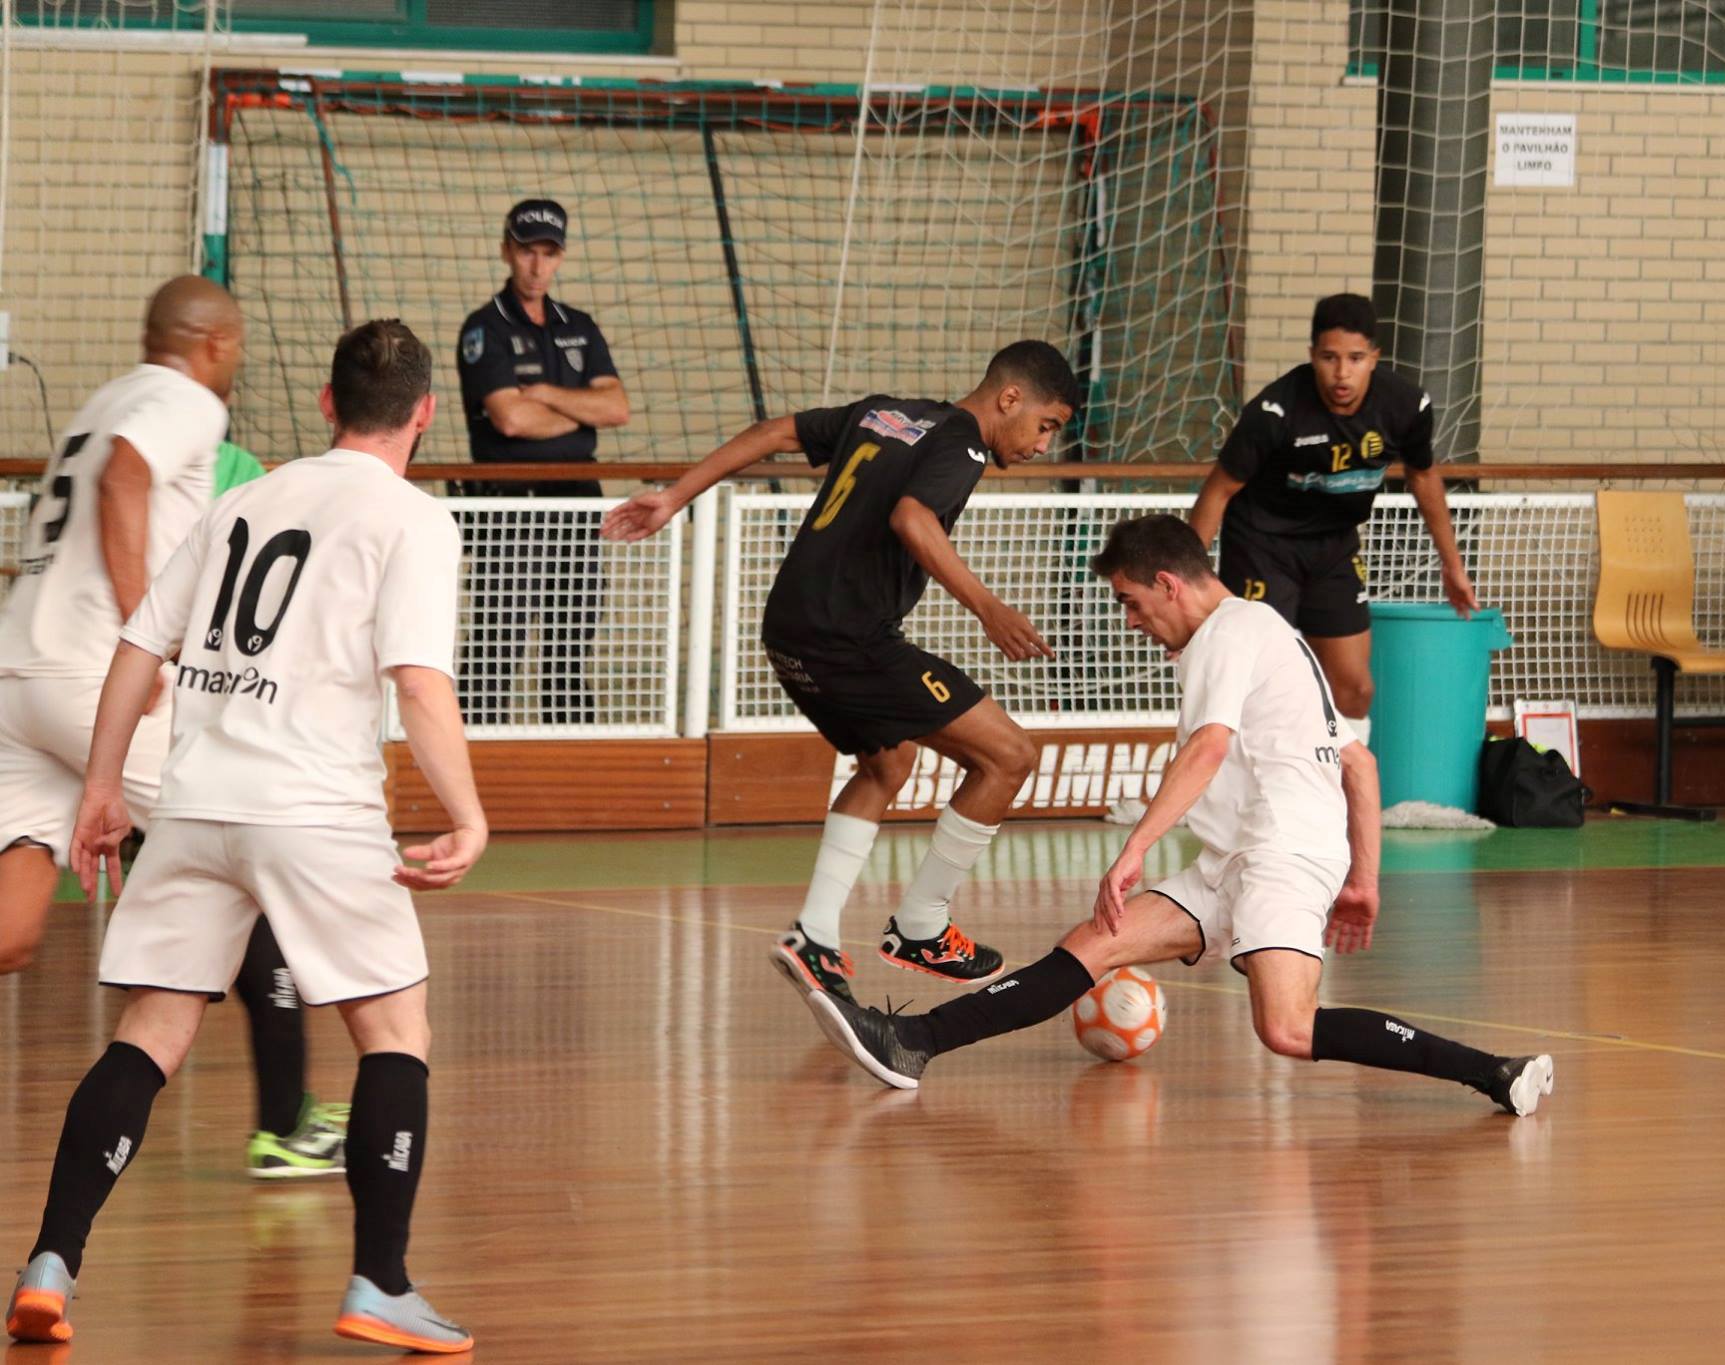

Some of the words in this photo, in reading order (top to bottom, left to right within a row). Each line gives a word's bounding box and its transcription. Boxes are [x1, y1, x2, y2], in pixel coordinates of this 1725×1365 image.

[1502, 144, 1510, 153] O
[1331, 443, 1352, 473] 12
[812, 441, 881, 531] 6
[203, 516, 311, 657] 10
[921, 670, 950, 704] 6
